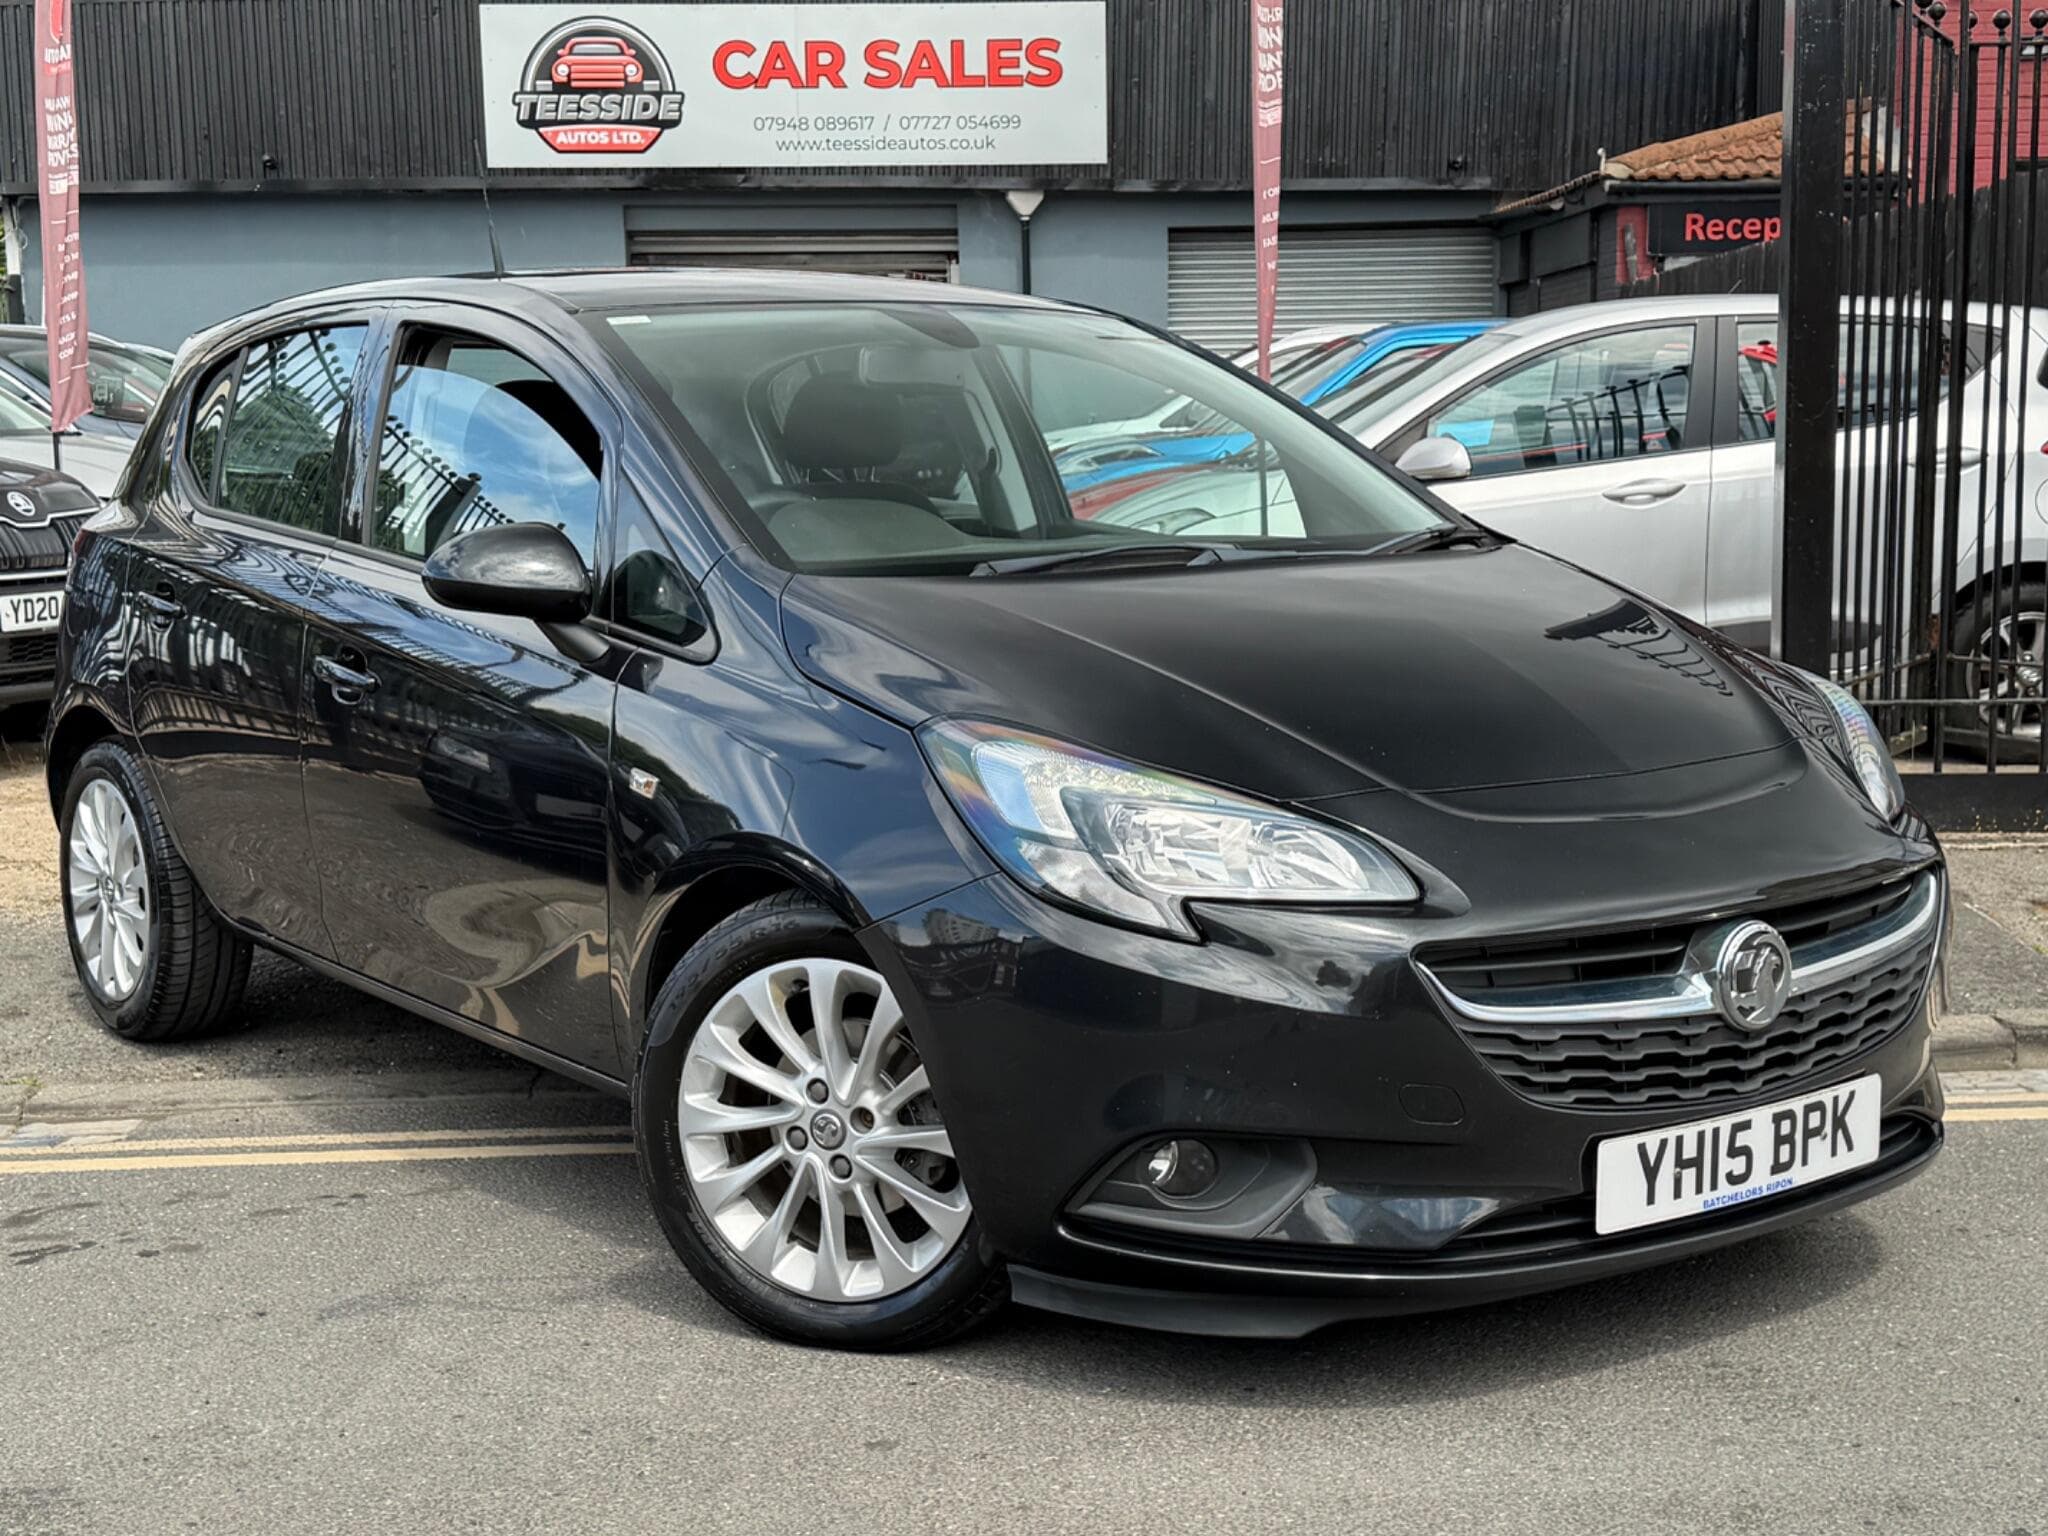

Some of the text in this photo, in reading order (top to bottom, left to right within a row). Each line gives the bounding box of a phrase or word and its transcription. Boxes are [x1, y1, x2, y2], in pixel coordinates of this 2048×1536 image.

[712, 38, 1064, 90] CAR SALES
[515, 93, 683, 121] TEESSIDE
[753, 116, 809, 131] 07948
[814, 116, 875, 131] 089617
[899, 115, 951, 130] 07727
[956, 114, 1022, 130] 054699
[556, 130, 645, 144] AUTOS LTD.
[776, 135, 997, 152] www.teessideautos.co.uk
[10, 596, 59, 624] YD20
[1637, 1089, 1856, 1206] YH15 BPK
[1703, 1177, 1794, 1209] BATCHELORS RIPON
